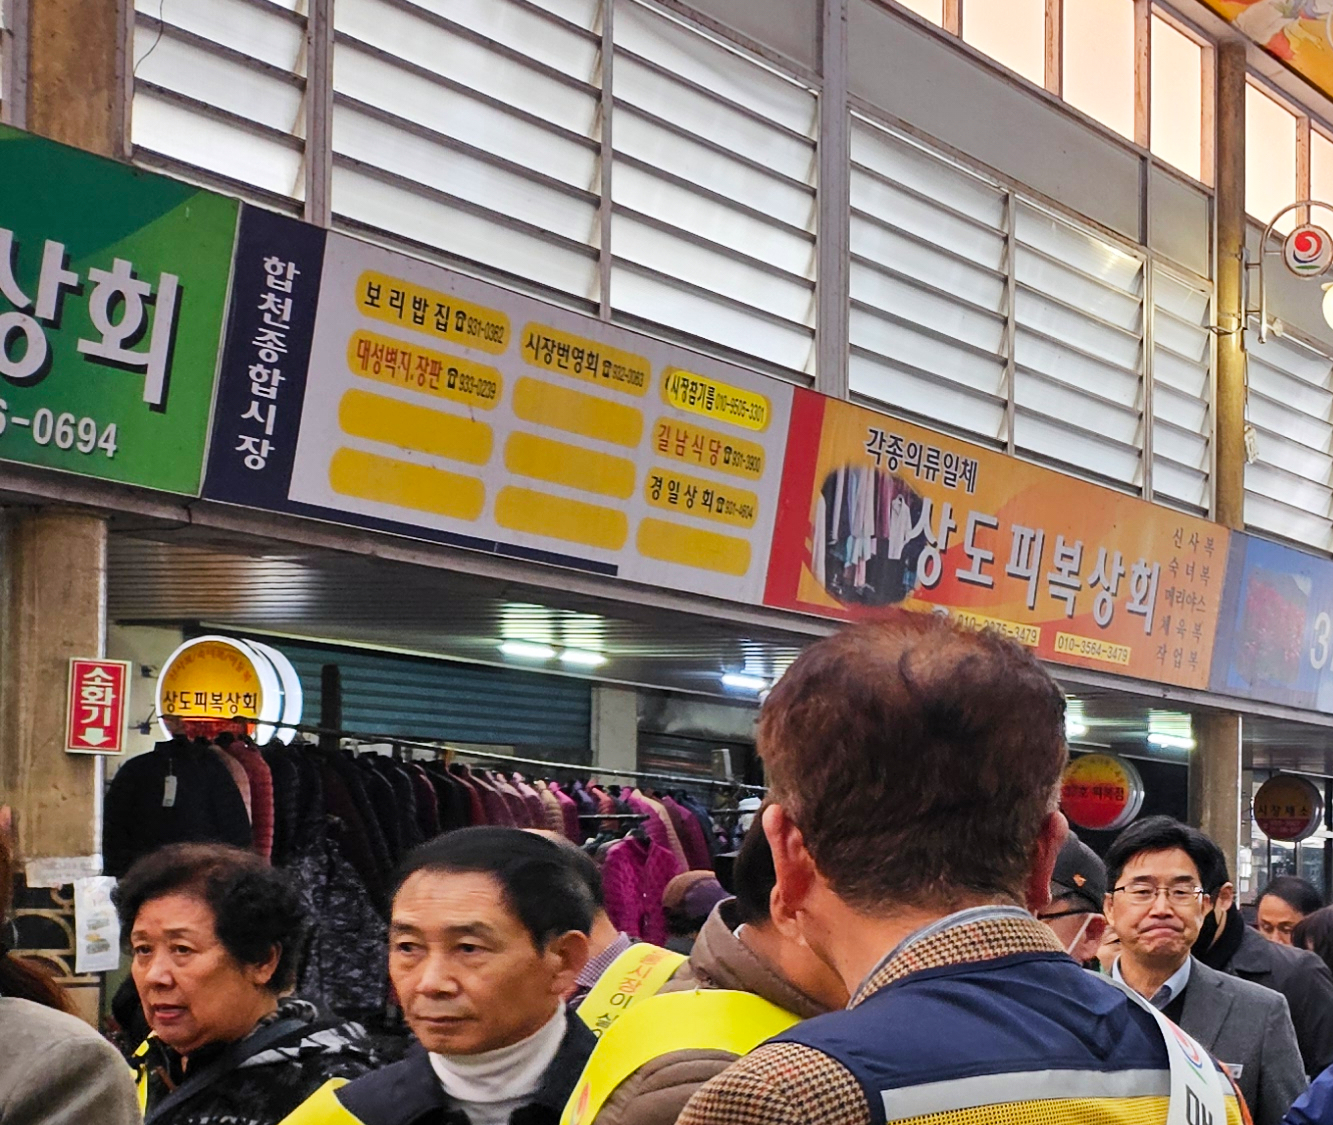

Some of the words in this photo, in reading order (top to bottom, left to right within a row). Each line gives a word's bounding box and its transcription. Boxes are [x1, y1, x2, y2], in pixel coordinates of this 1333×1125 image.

[364, 281, 450, 332] 보리밥집
[235, 256, 300, 470] 합천종합시장
[525, 331, 600, 378] 시장번영회
[671, 374, 716, 411] 시장참기름
[658, 424, 722, 466] 길남식당
[866, 428, 978, 494] 각종의류일체
[650, 476, 713, 511] 경일상회
[1172, 526, 1214, 558] 신사복
[907, 497, 1162, 635] 상도피복상회
[1058, 636, 1129, 662] 010-3564-3479
[80, 666, 116, 728] 소화기
[163, 691, 257, 714] 상도피복상회
